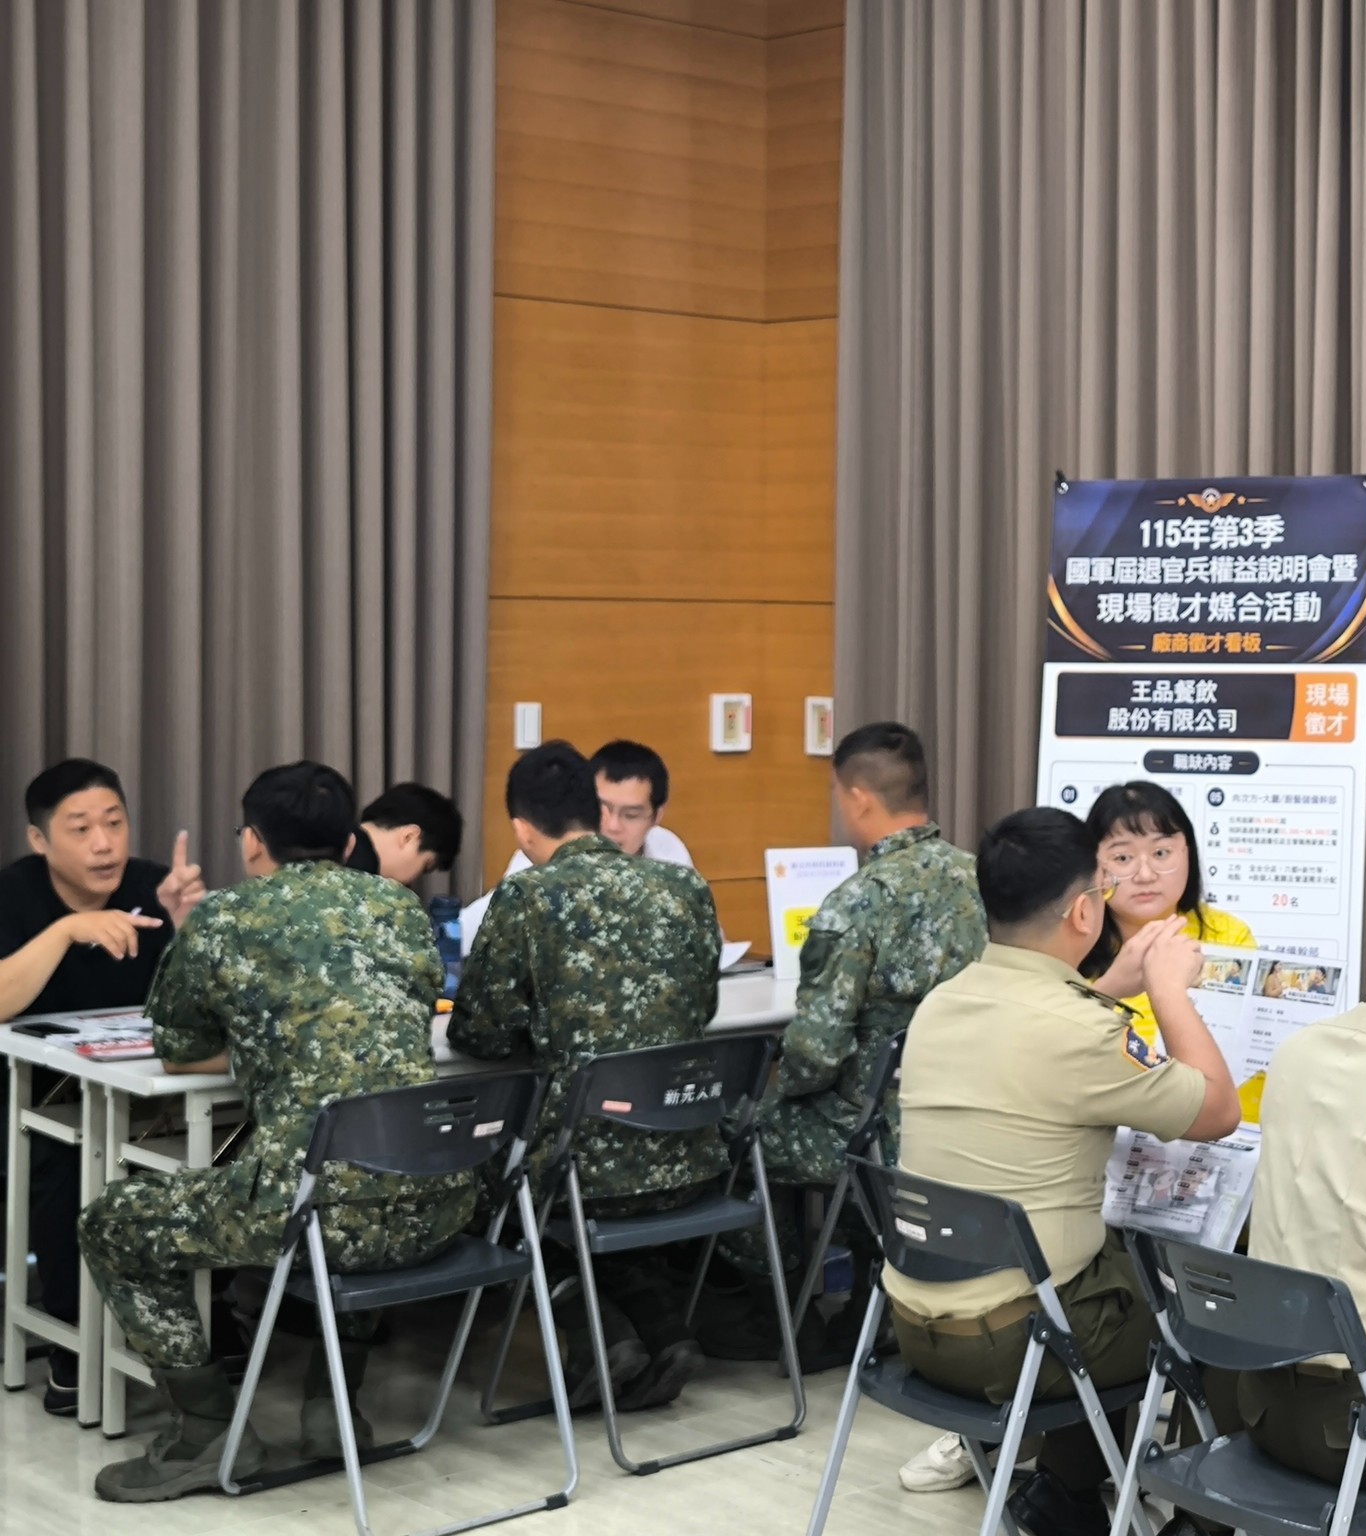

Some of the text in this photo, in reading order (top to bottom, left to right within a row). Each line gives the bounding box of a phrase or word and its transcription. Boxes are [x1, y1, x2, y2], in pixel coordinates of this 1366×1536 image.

[1139, 514, 1285, 550] 115年第3季
[1066, 553, 1358, 585] 國軍屆退官兵權益說明會暨
[1096, 591, 1322, 624] 現場徵才媒合活動
[1151, 632, 1262, 654] 廠商徵才看板
[1130, 680, 1218, 703] 王品餐飲
[1305, 683, 1350, 707] 現場
[1107, 708, 1238, 733] 股份有限公司
[1304, 712, 1349, 736] 徵才
[1062, 788, 1077, 801] 01
